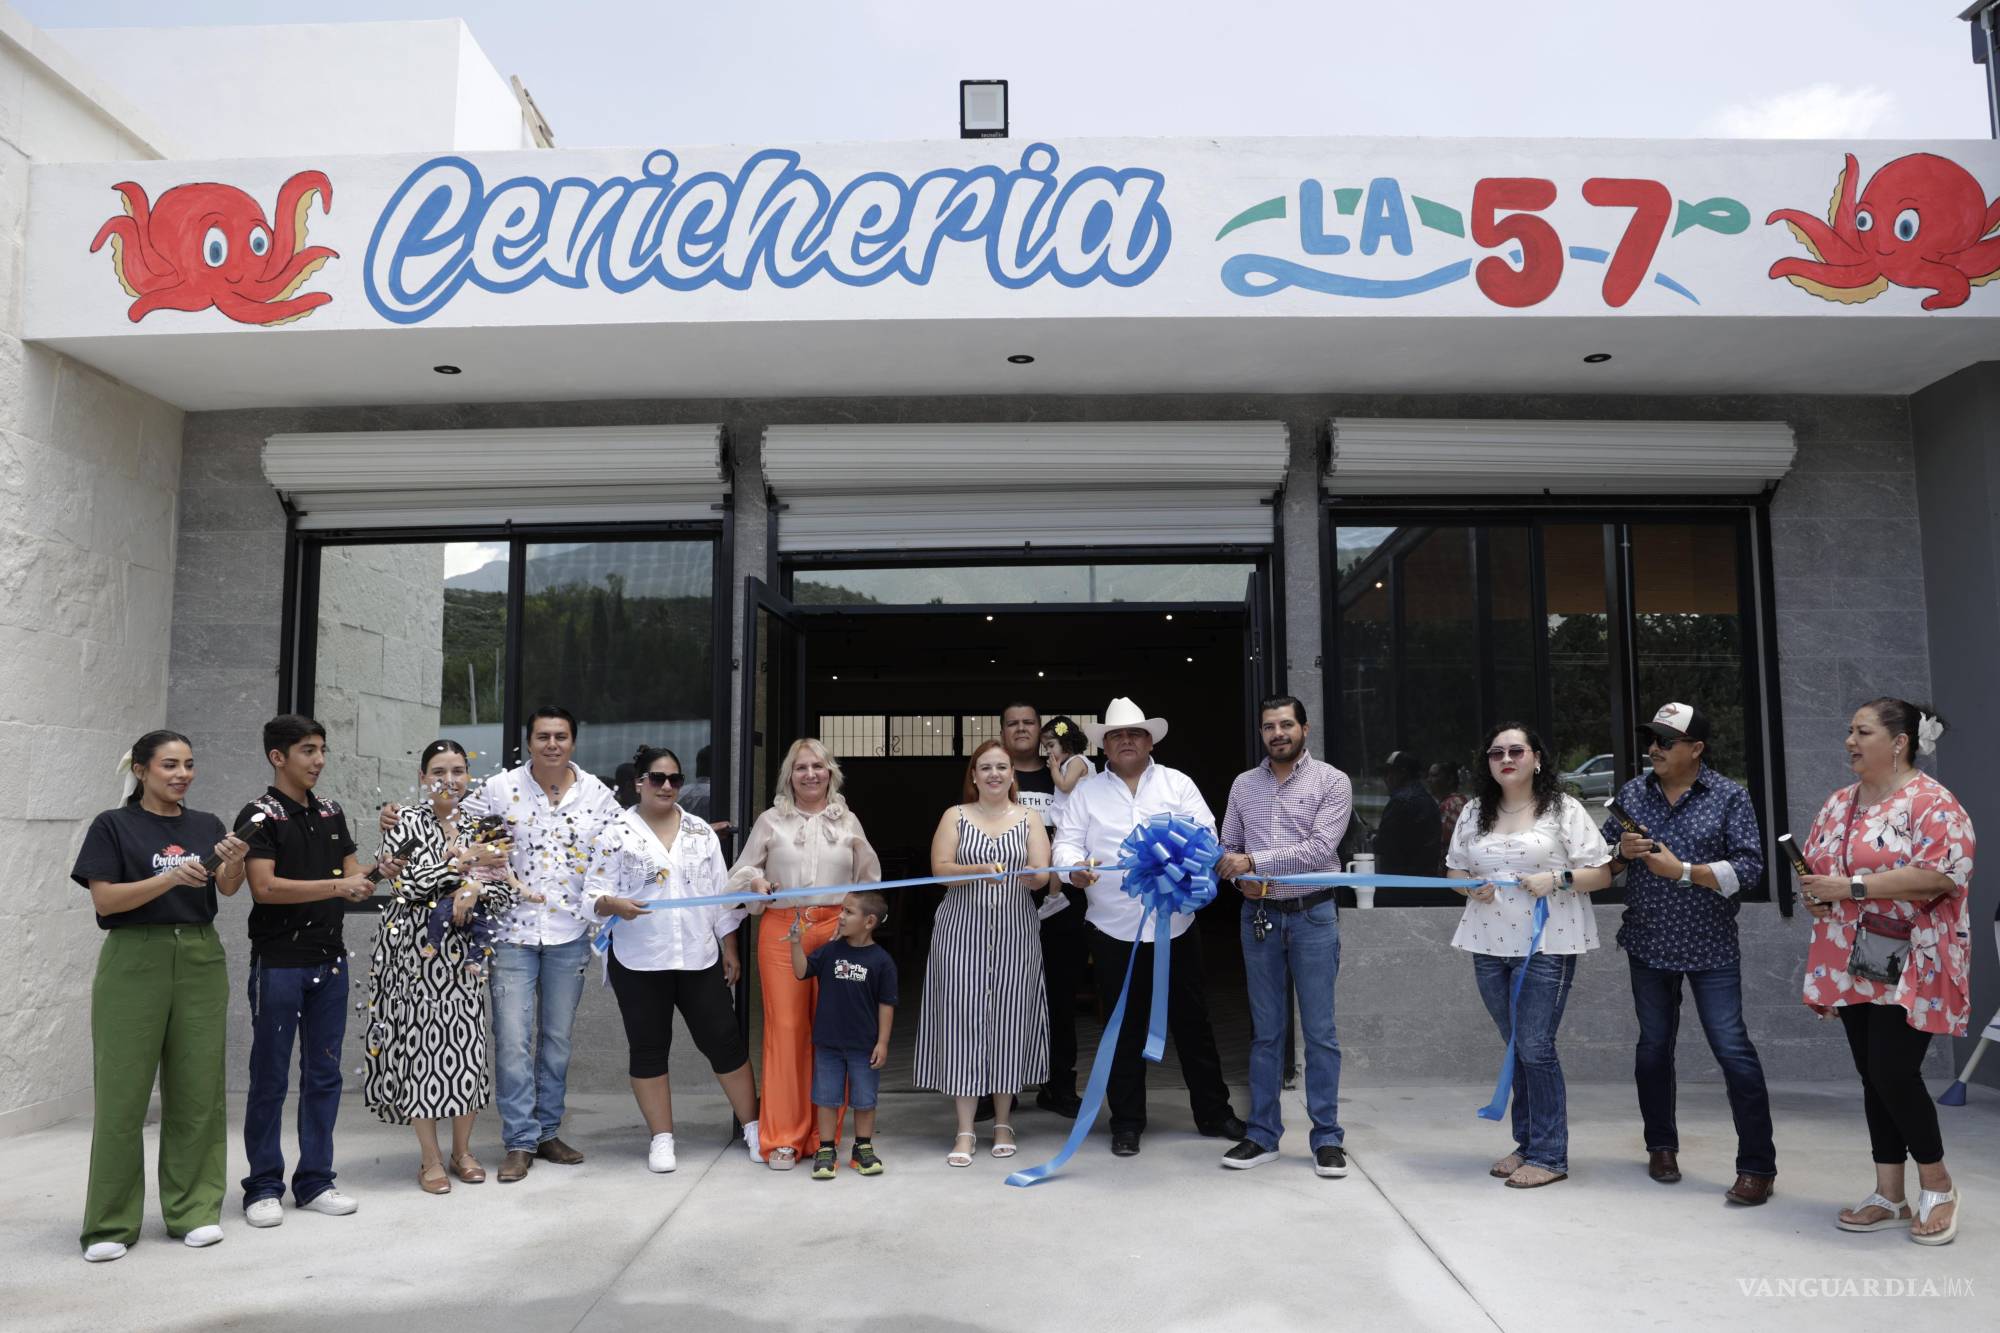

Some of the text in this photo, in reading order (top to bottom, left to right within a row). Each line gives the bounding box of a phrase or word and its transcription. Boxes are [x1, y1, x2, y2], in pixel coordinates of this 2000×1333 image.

[364, 143, 1673, 323] Cevicheria LA 57
